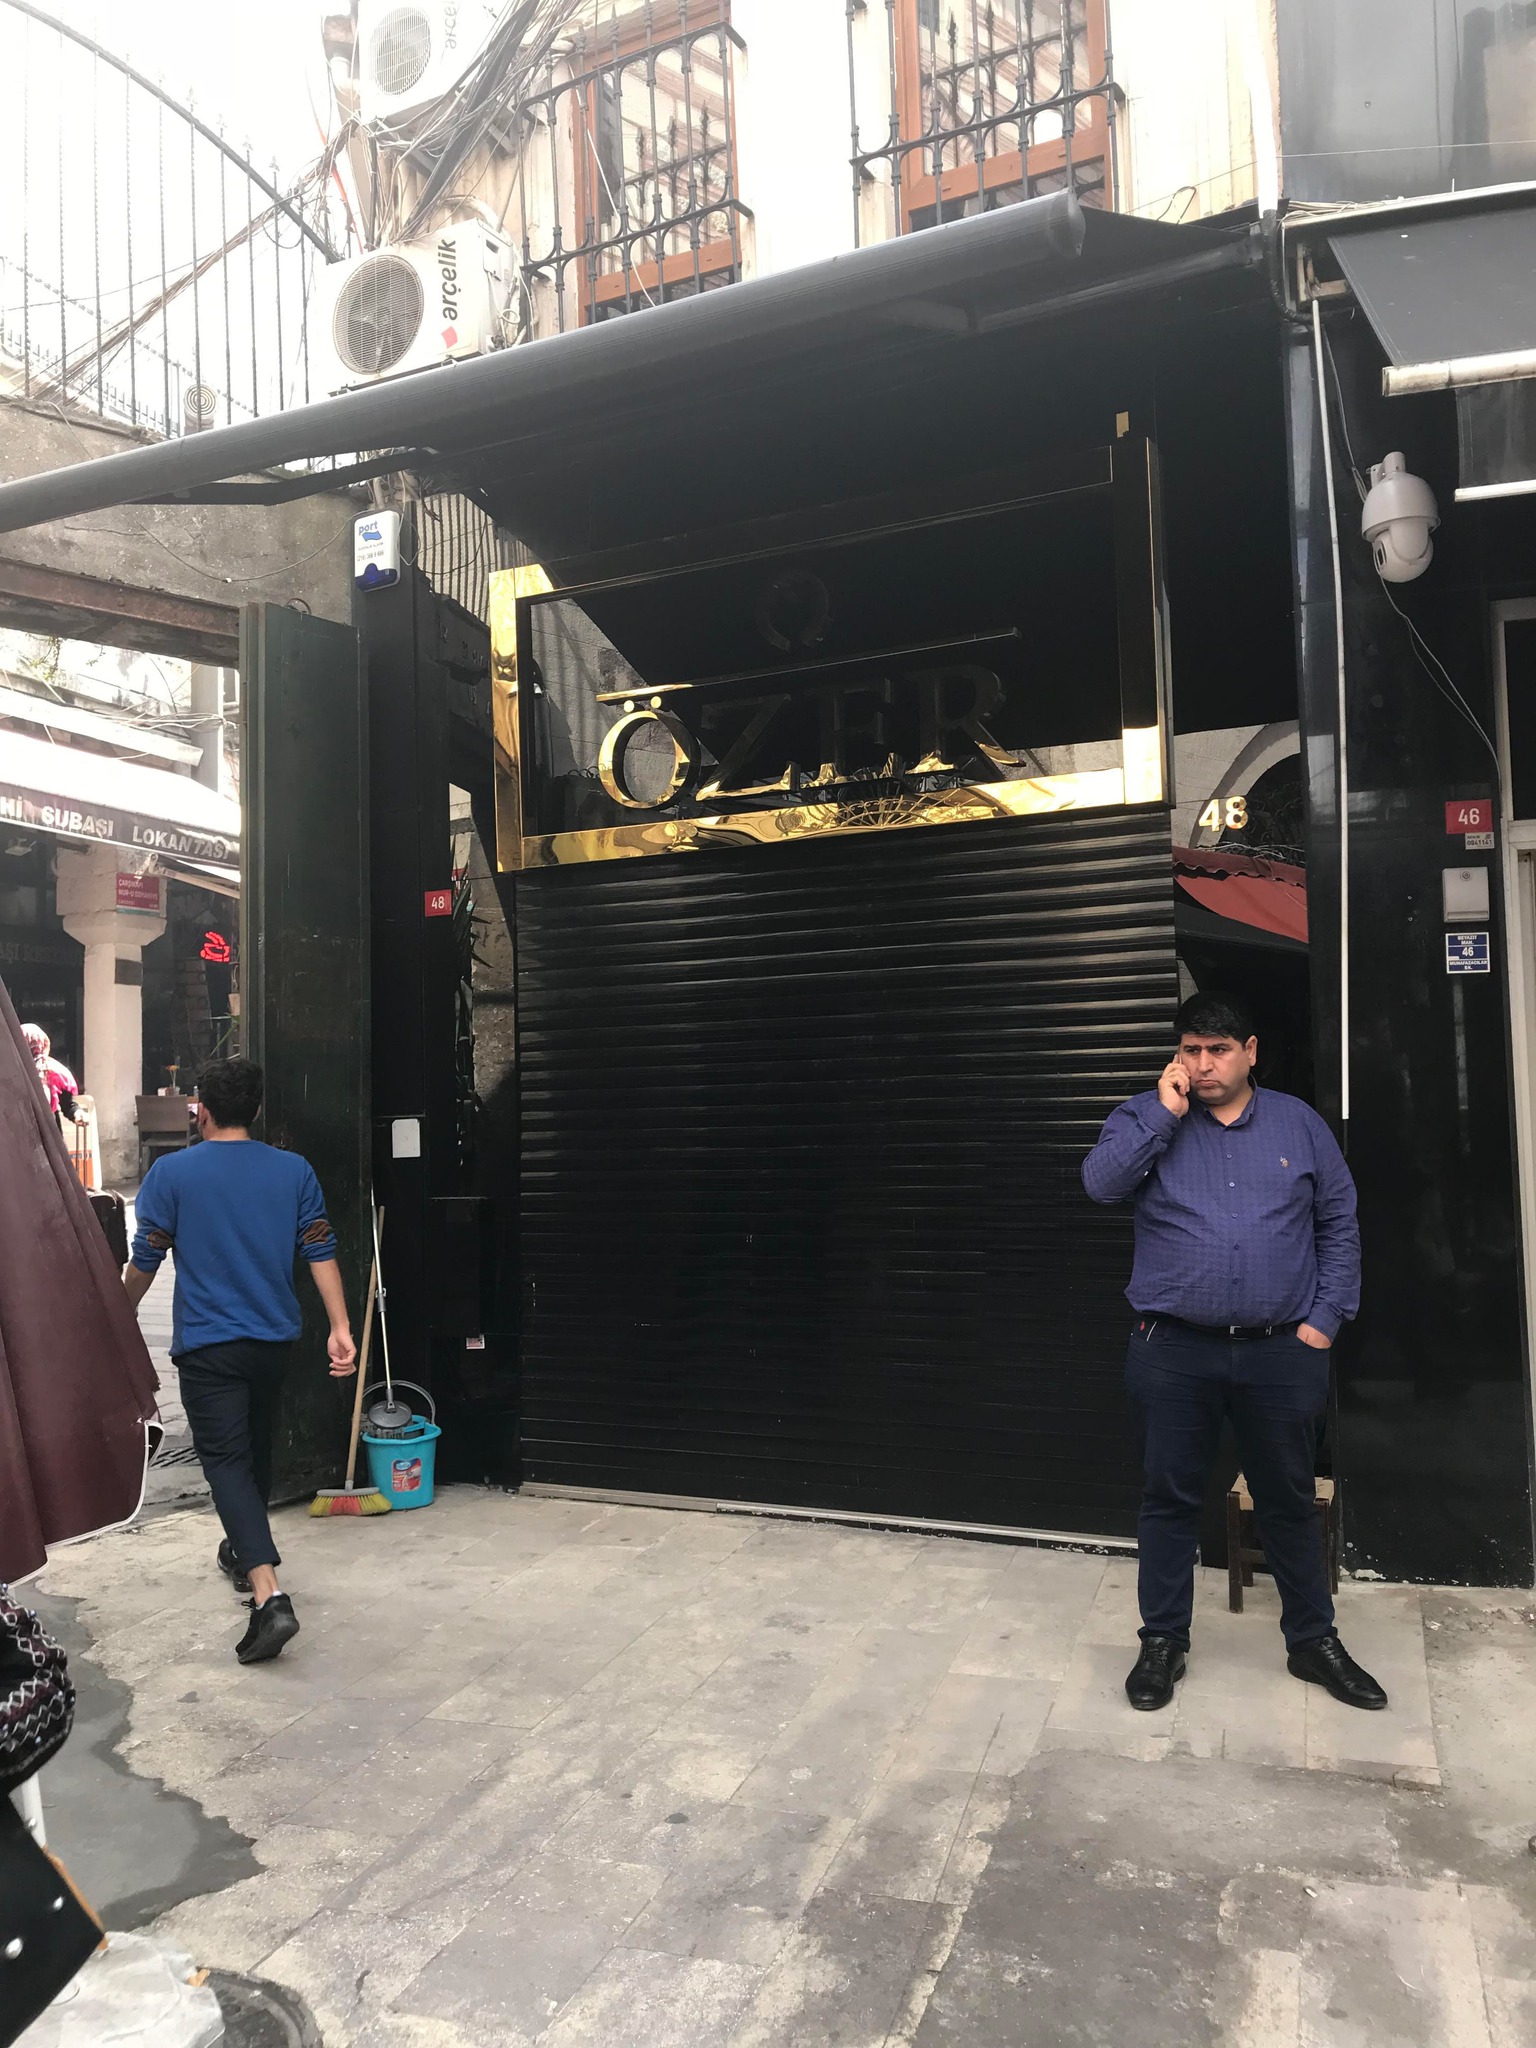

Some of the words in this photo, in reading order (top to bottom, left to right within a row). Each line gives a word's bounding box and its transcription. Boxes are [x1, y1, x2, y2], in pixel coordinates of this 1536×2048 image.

[438, 239, 461, 321] arçelik
[358, 521, 378, 536] port
[598, 662, 1027, 809] ÖZER
[1198, 795, 1249, 832] 48
[1458, 807, 1480, 825] 46
[41, 805, 114, 840] SUBAŞI
[132, 825, 230, 860] LOKANTASI
[431, 895, 445, 910] 48
[1462, 946, 1475, 957] 46
